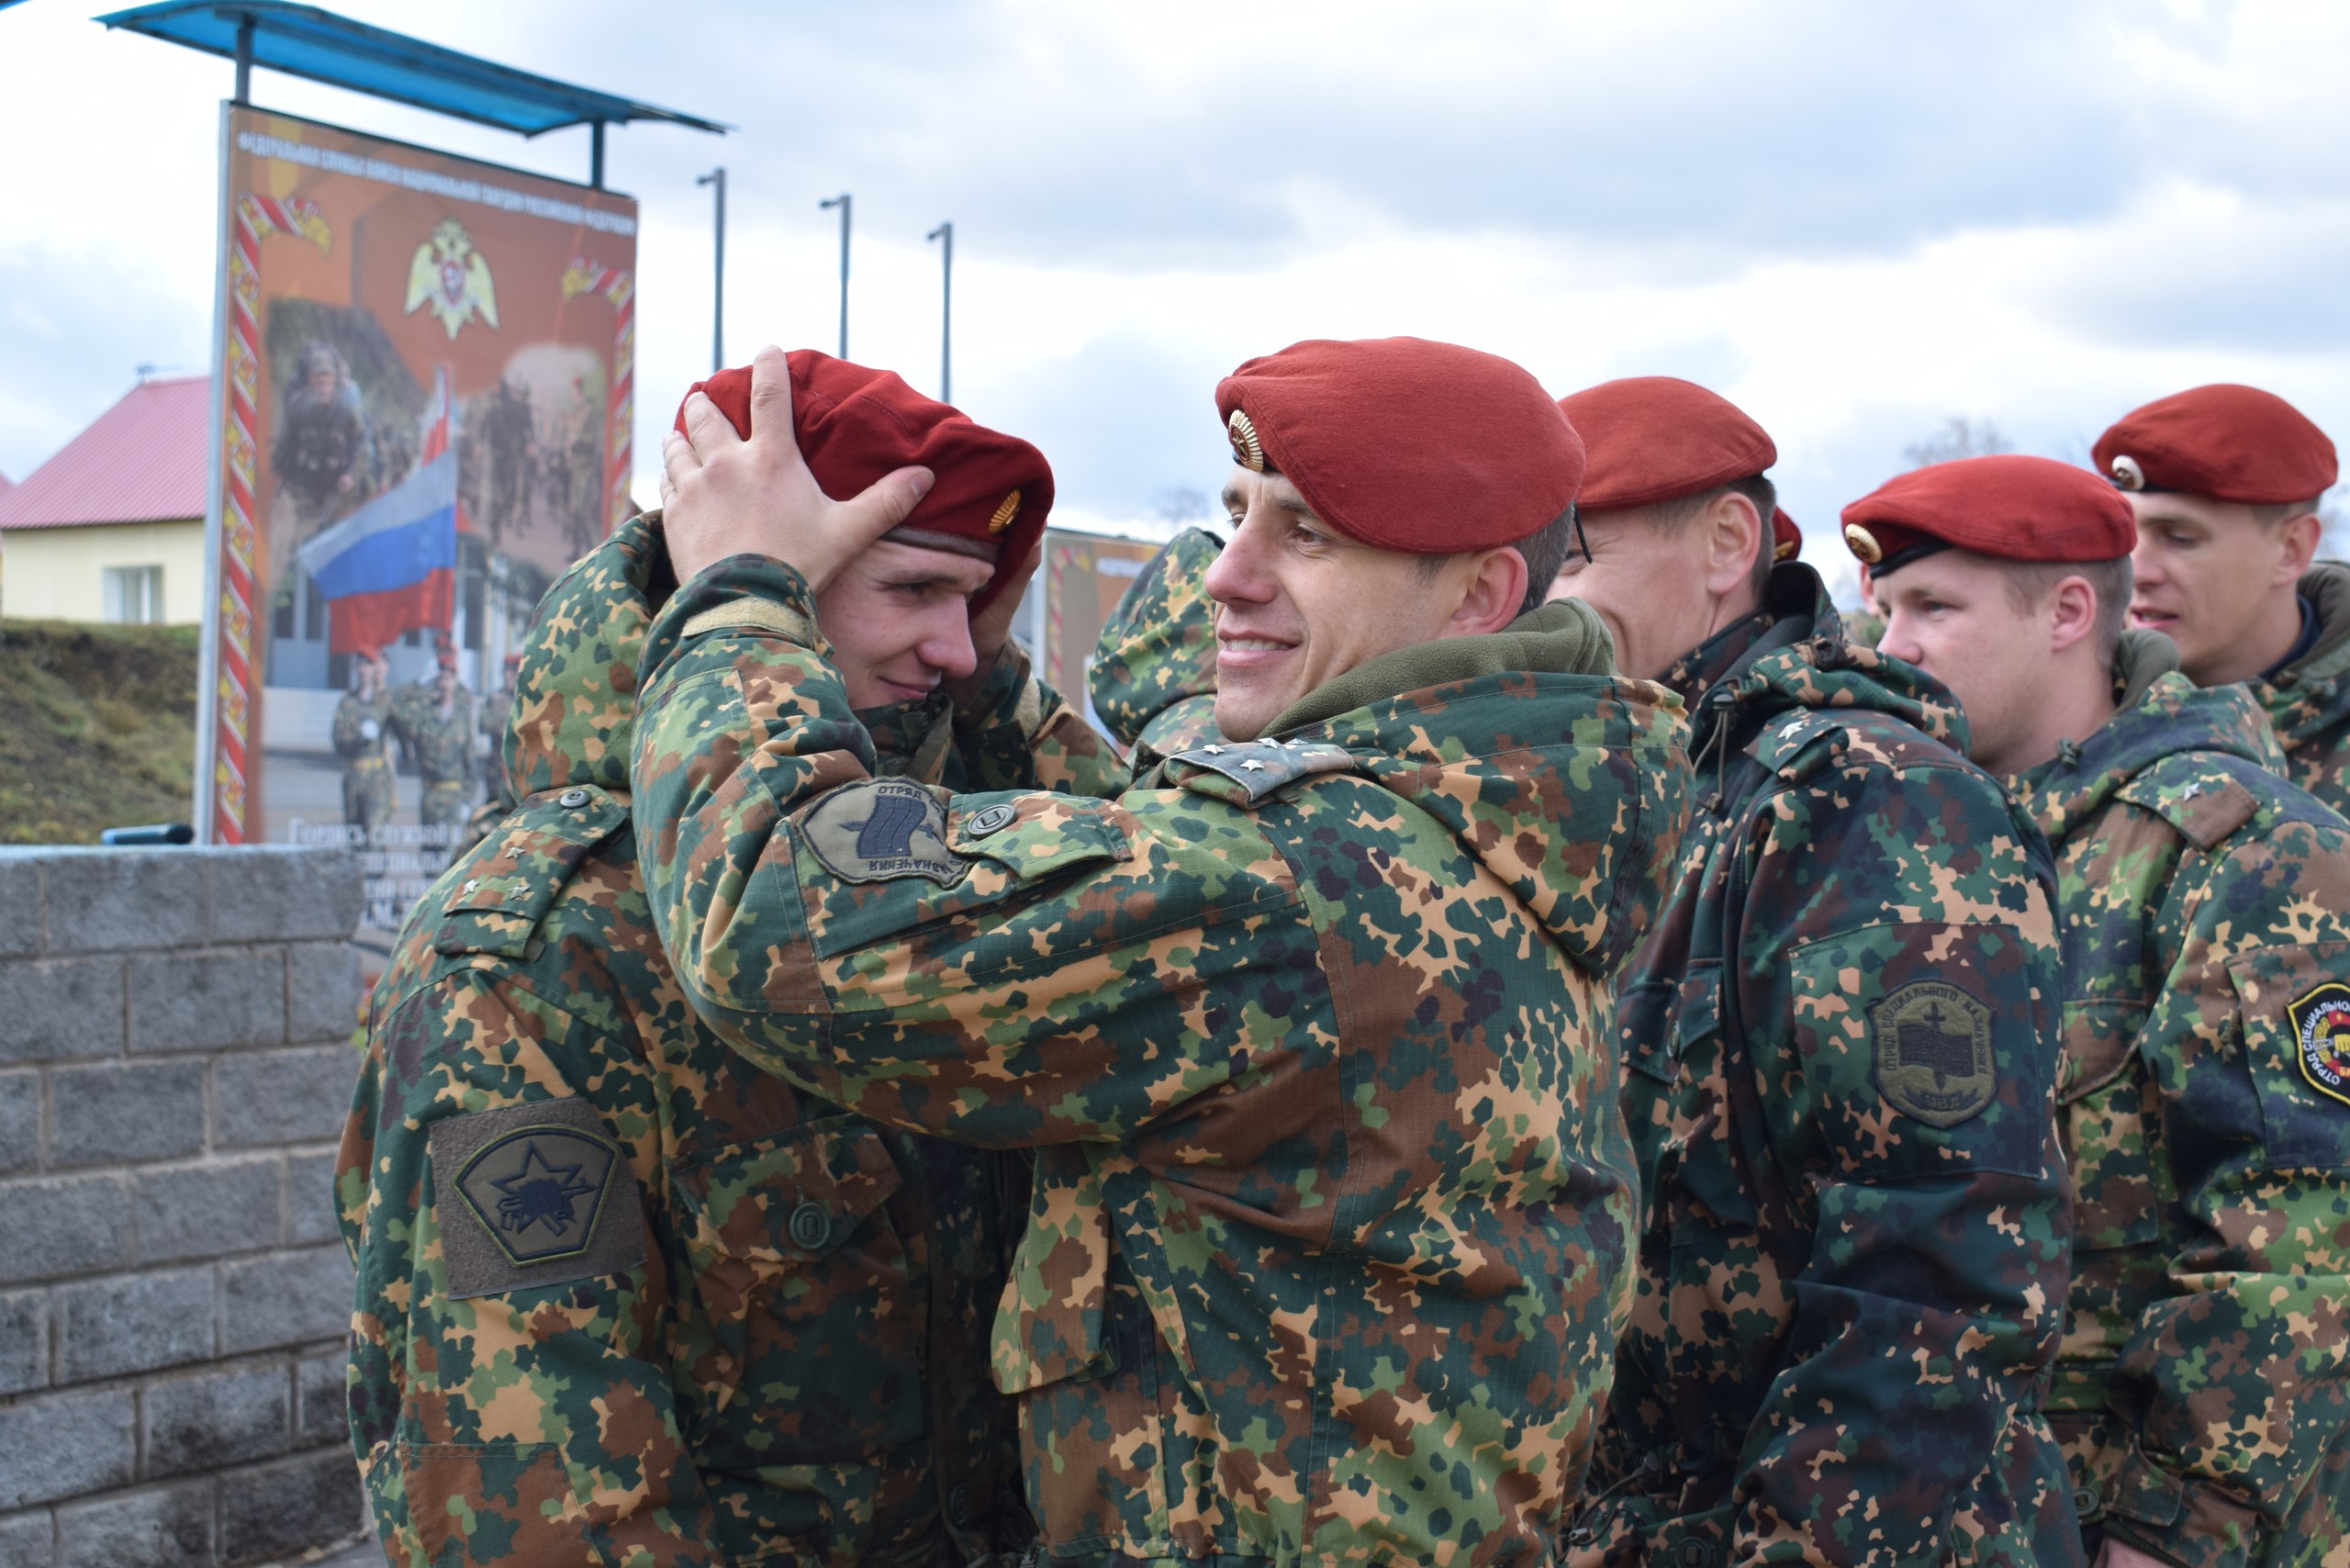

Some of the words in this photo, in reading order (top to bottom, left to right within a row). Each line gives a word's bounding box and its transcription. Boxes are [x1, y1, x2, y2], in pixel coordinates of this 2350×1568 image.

[878, 786, 923, 800] ОТРЯД
[1883, 986, 1959, 1028] СПЕЦИАЛЬНОГО
[2302, 1000, 2350, 1051] СПЕЦИАЛЬНО
[1885, 1036, 1897, 1071] ОТРЯД
[1963, 1000, 1988, 1075] НАЗНАЧЕНИЯ
[2306, 1051, 2341, 1086] ОТРЯД
